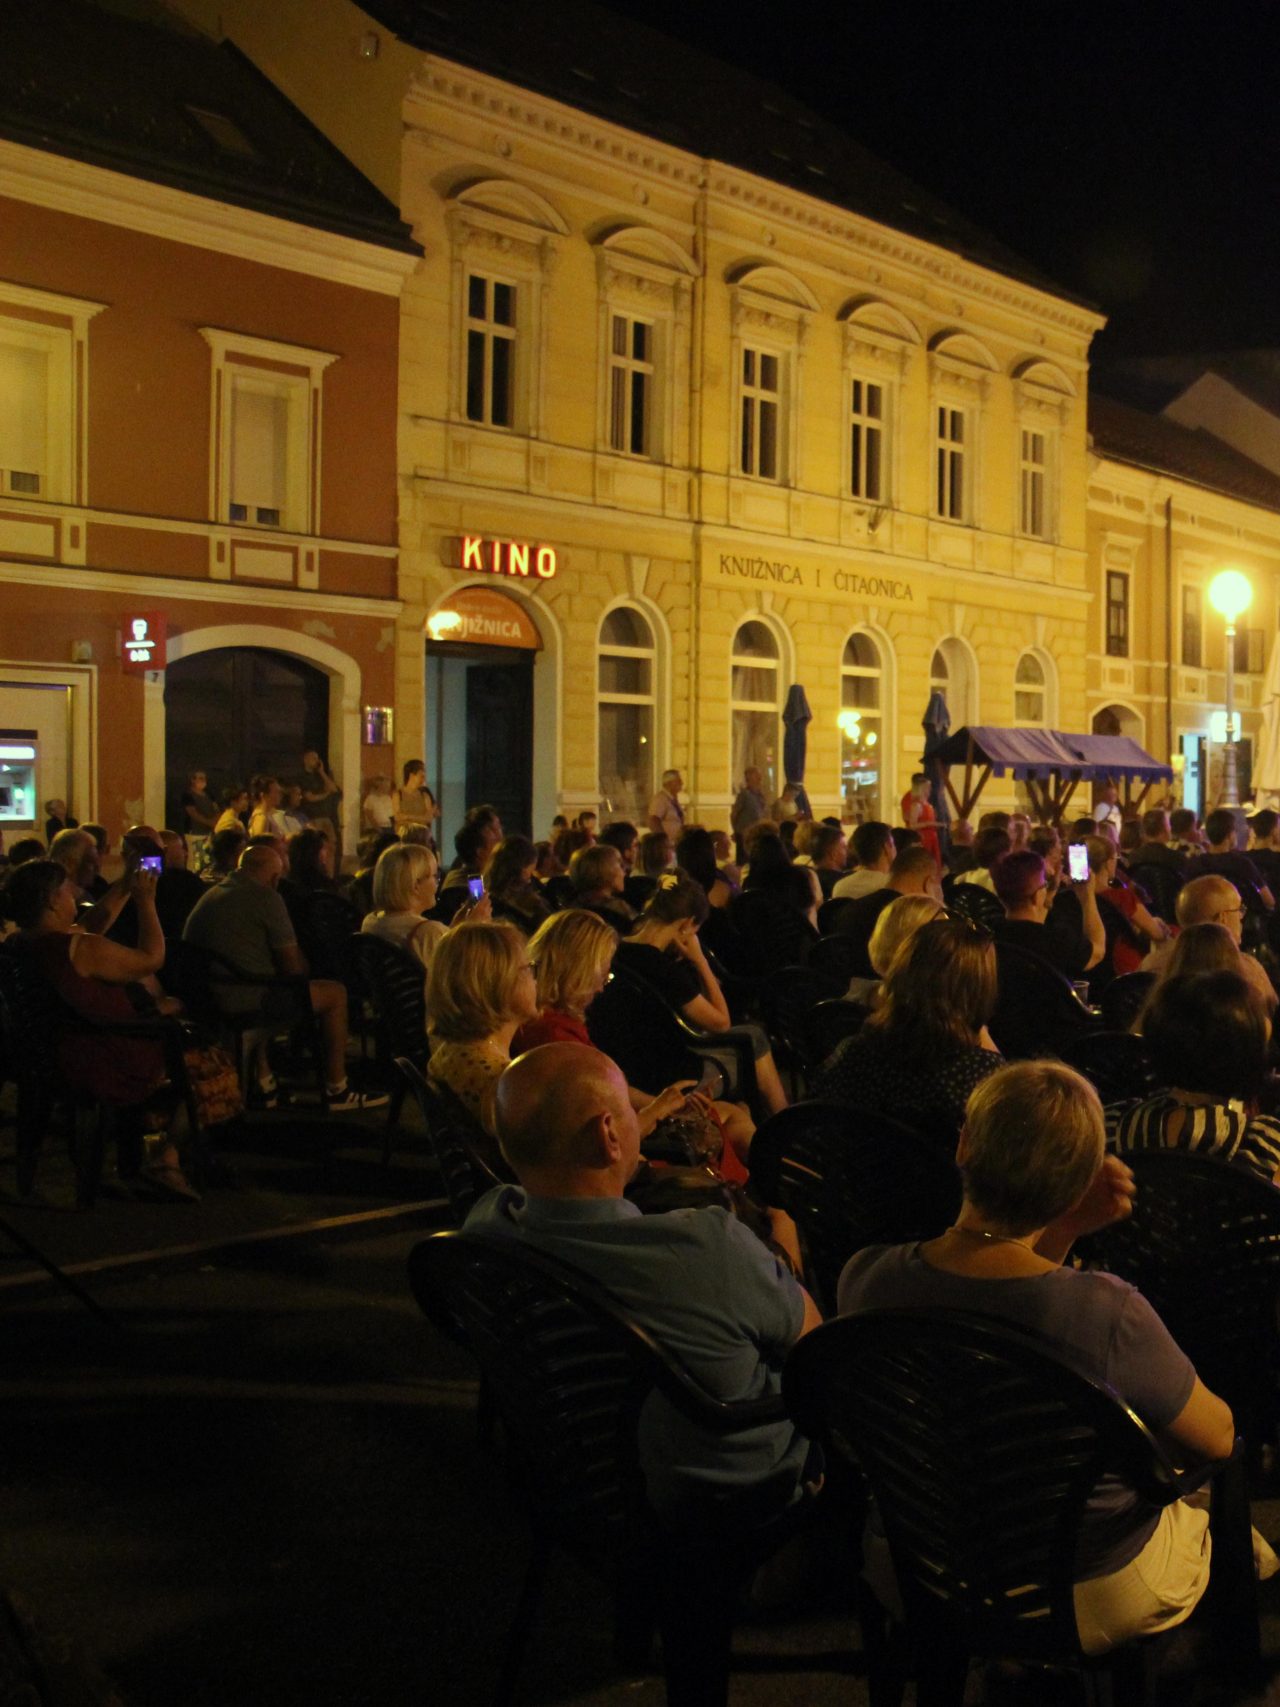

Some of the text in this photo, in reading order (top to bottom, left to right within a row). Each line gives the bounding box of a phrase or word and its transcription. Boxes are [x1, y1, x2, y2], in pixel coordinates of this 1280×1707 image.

[463, 536, 557, 577] KINO
[719, 554, 914, 601] KNJIŽNICA I ČITAONICA
